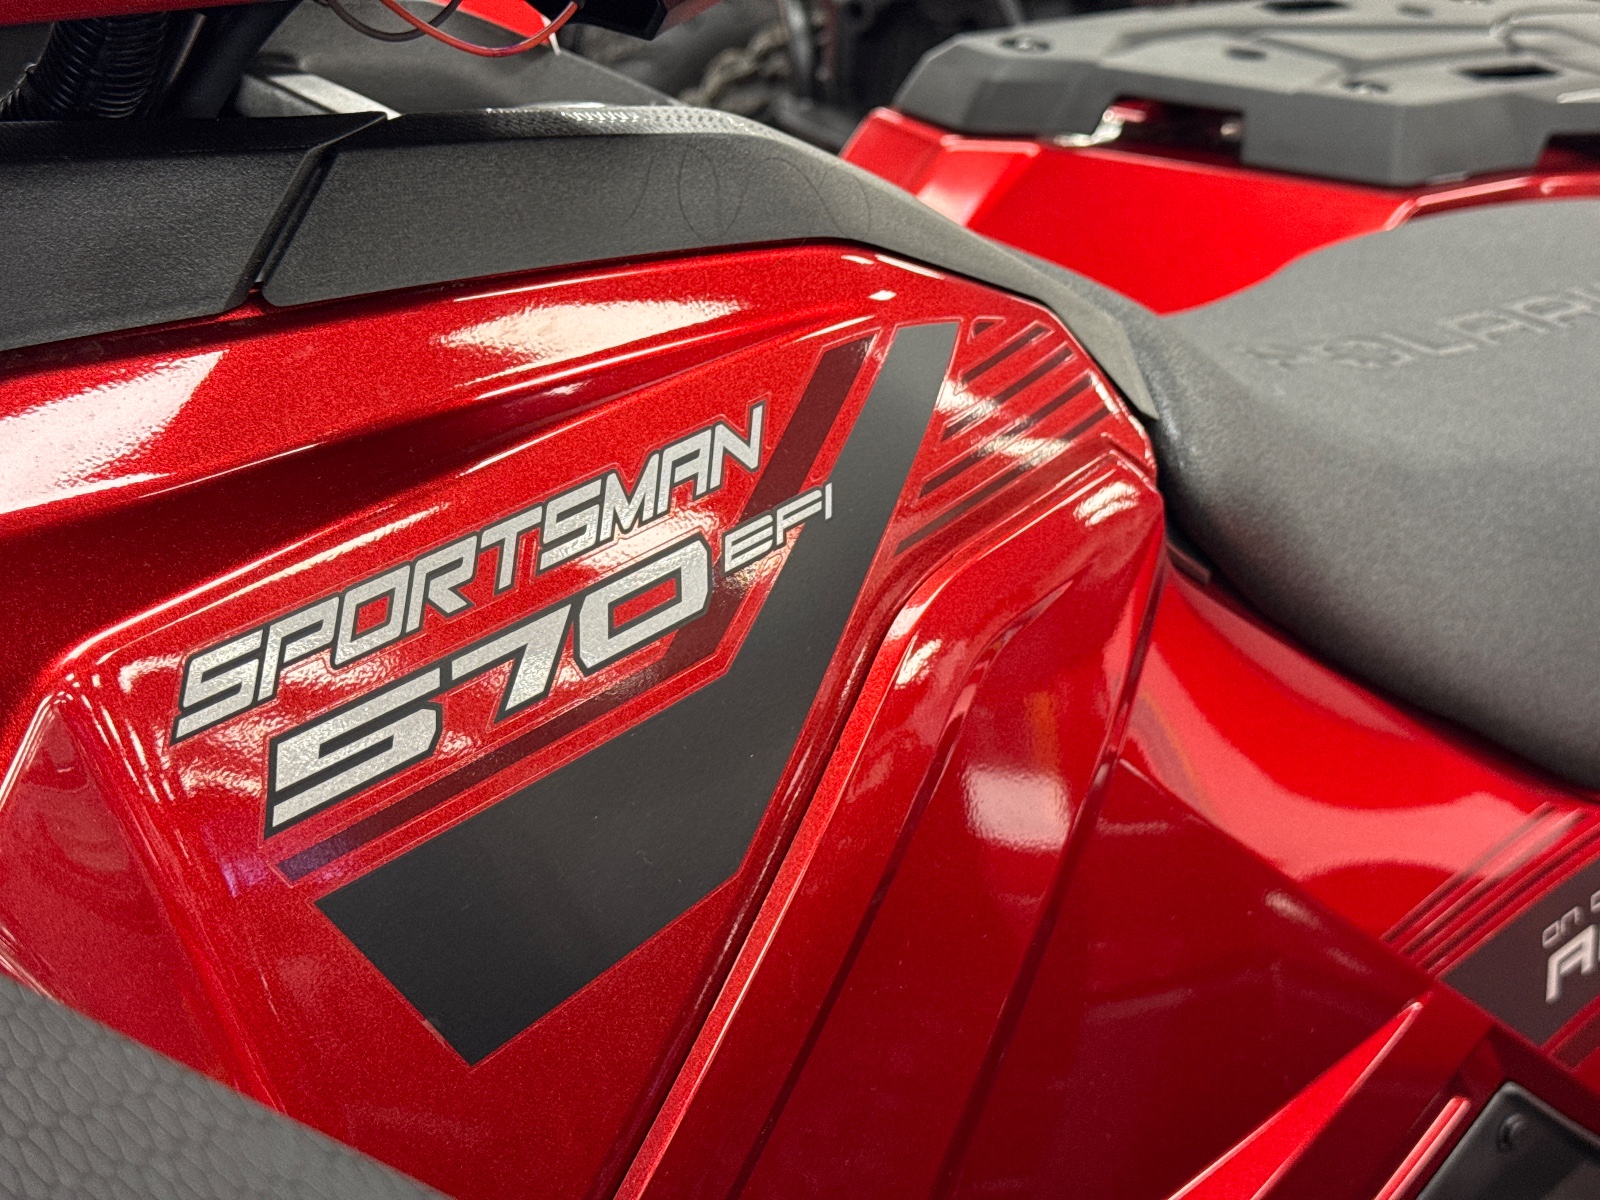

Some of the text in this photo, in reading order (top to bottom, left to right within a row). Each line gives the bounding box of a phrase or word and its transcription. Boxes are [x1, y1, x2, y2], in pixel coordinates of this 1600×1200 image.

[171, 399, 767, 743] SPORTSMAN
[265, 483, 834, 838] 570 EFI
